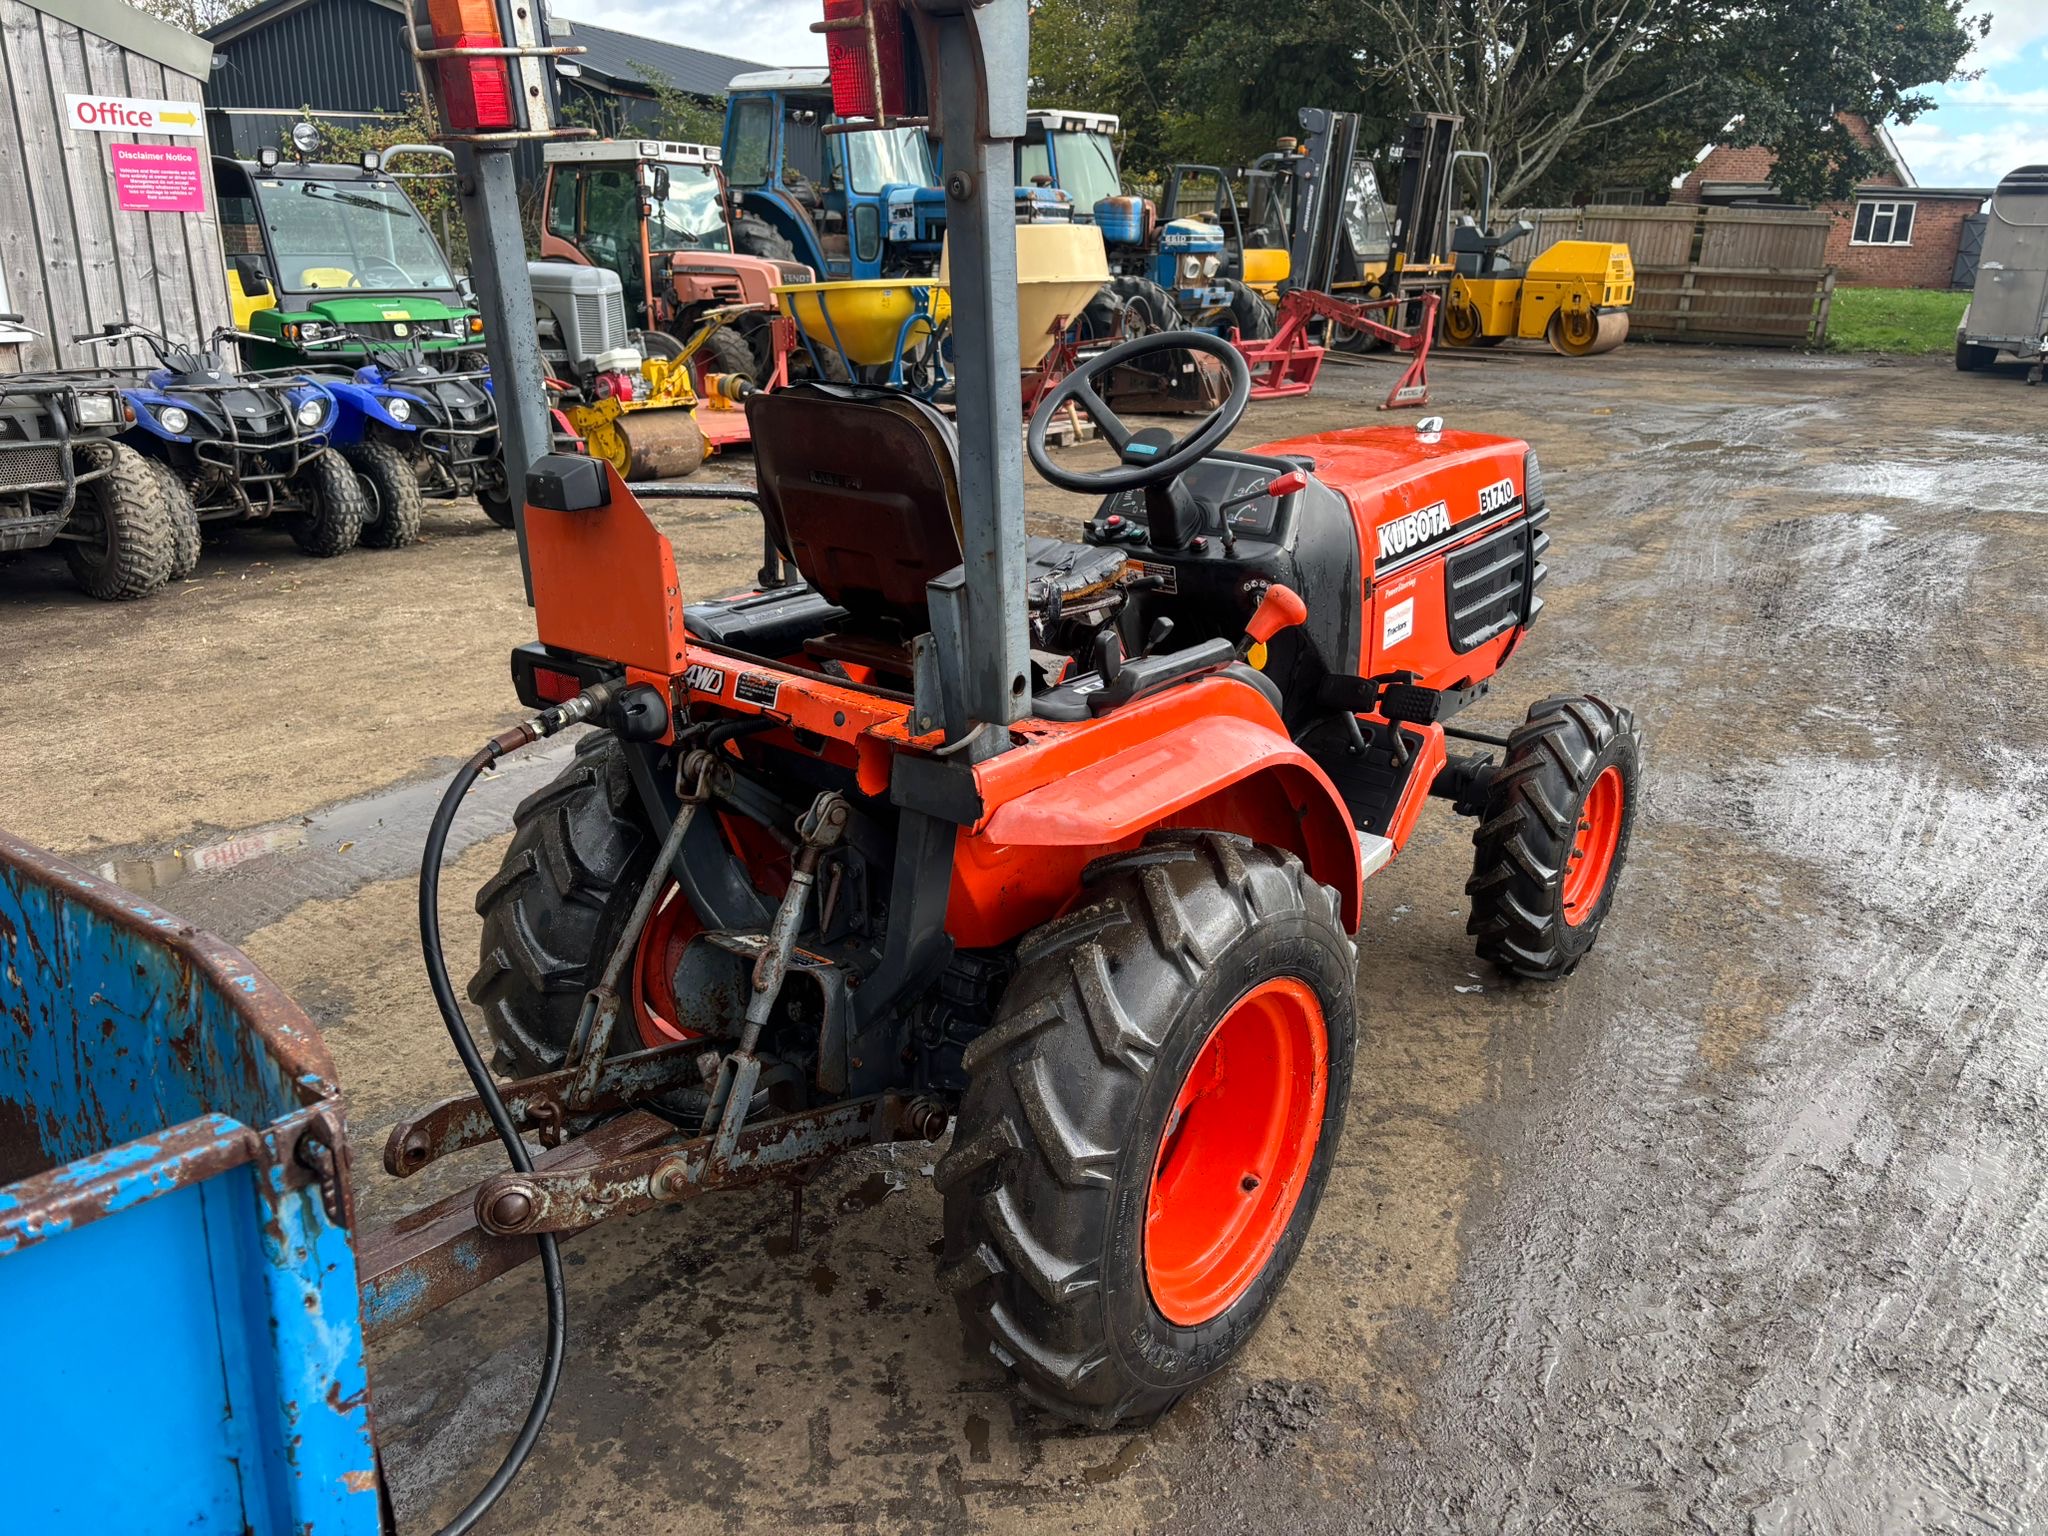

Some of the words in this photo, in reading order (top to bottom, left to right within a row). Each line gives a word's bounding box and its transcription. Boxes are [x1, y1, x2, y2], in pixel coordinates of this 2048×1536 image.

[77, 102, 152, 127] Office
[118, 151, 163, 160] Disclaimer
[166, 153, 192, 162] Notice
[1389, 147, 1404, 157] CAT
[783, 273, 811, 283] FENDT
[1480, 481, 1513, 513] B1710
[1377, 502, 1450, 559] KUBOTA
[1387, 621, 1407, 637] Tractors
[684, 664, 724, 694] 4WD
